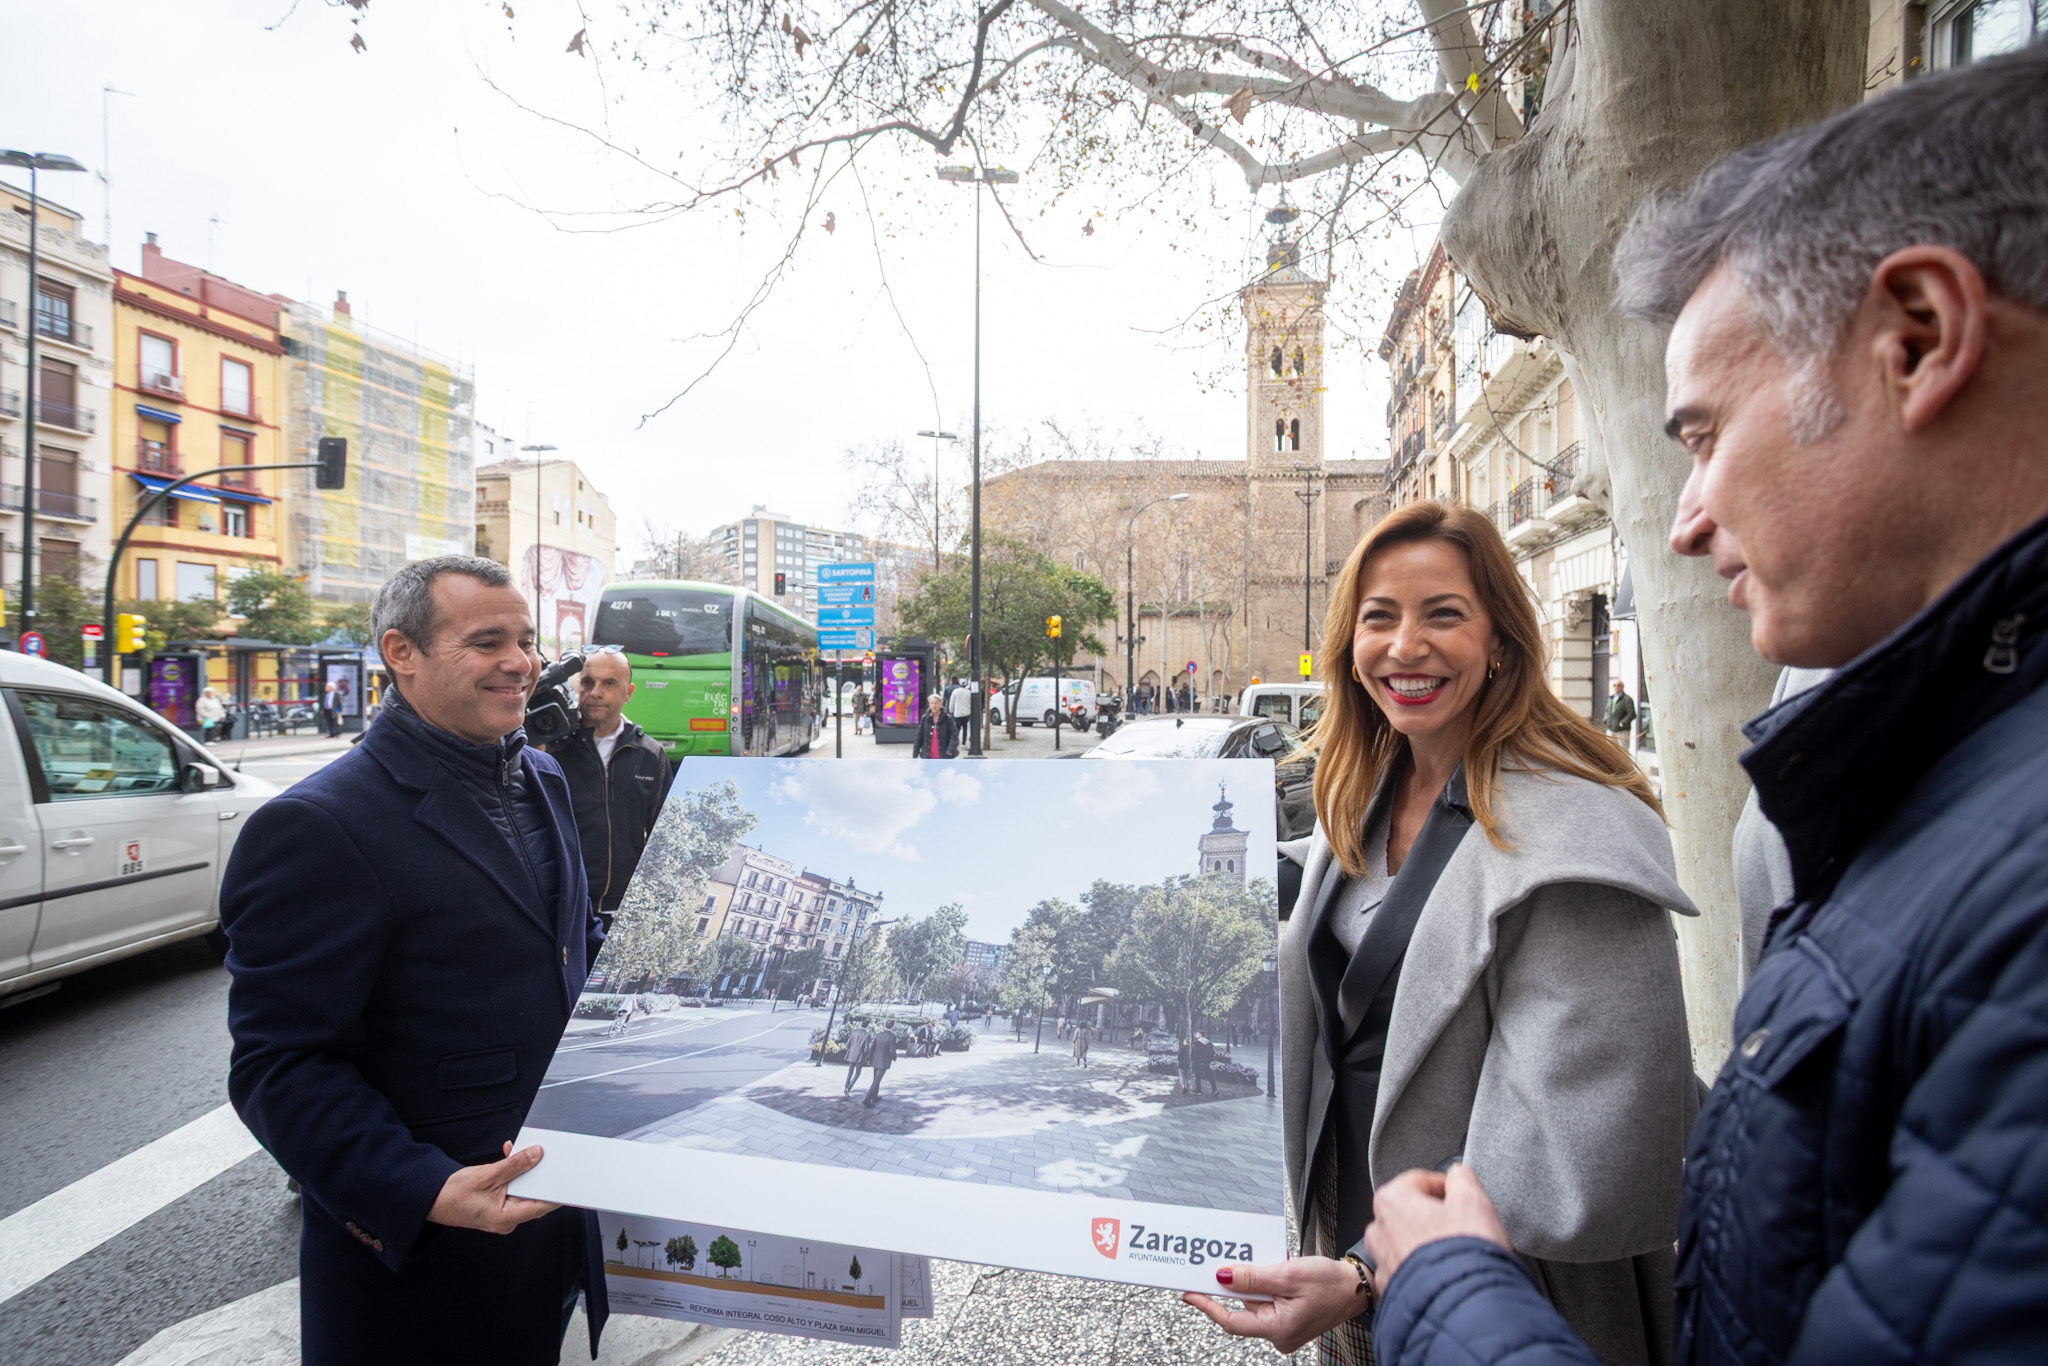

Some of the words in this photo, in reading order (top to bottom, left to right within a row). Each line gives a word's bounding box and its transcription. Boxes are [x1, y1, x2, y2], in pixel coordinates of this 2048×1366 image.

[832, 568, 872, 577] SARTOPINA
[610, 601, 632, 610] 4274
[1129, 1224, 1253, 1265] Zaragoza
[1129, 1252, 1185, 1265] AYUNTAMIENTO
[690, 1303, 724, 1316] REFORMA
[725, 1310, 762, 1320] INTEGRAL
[763, 1314, 785, 1323] COSO
[787, 1316, 806, 1326] ALTO
[808, 1319, 814, 1327] Y
[815, 1321, 838, 1331] PLAZA
[840, 1324, 855, 1334] SAN
[856, 1325, 886, 1336] MIGUEL
